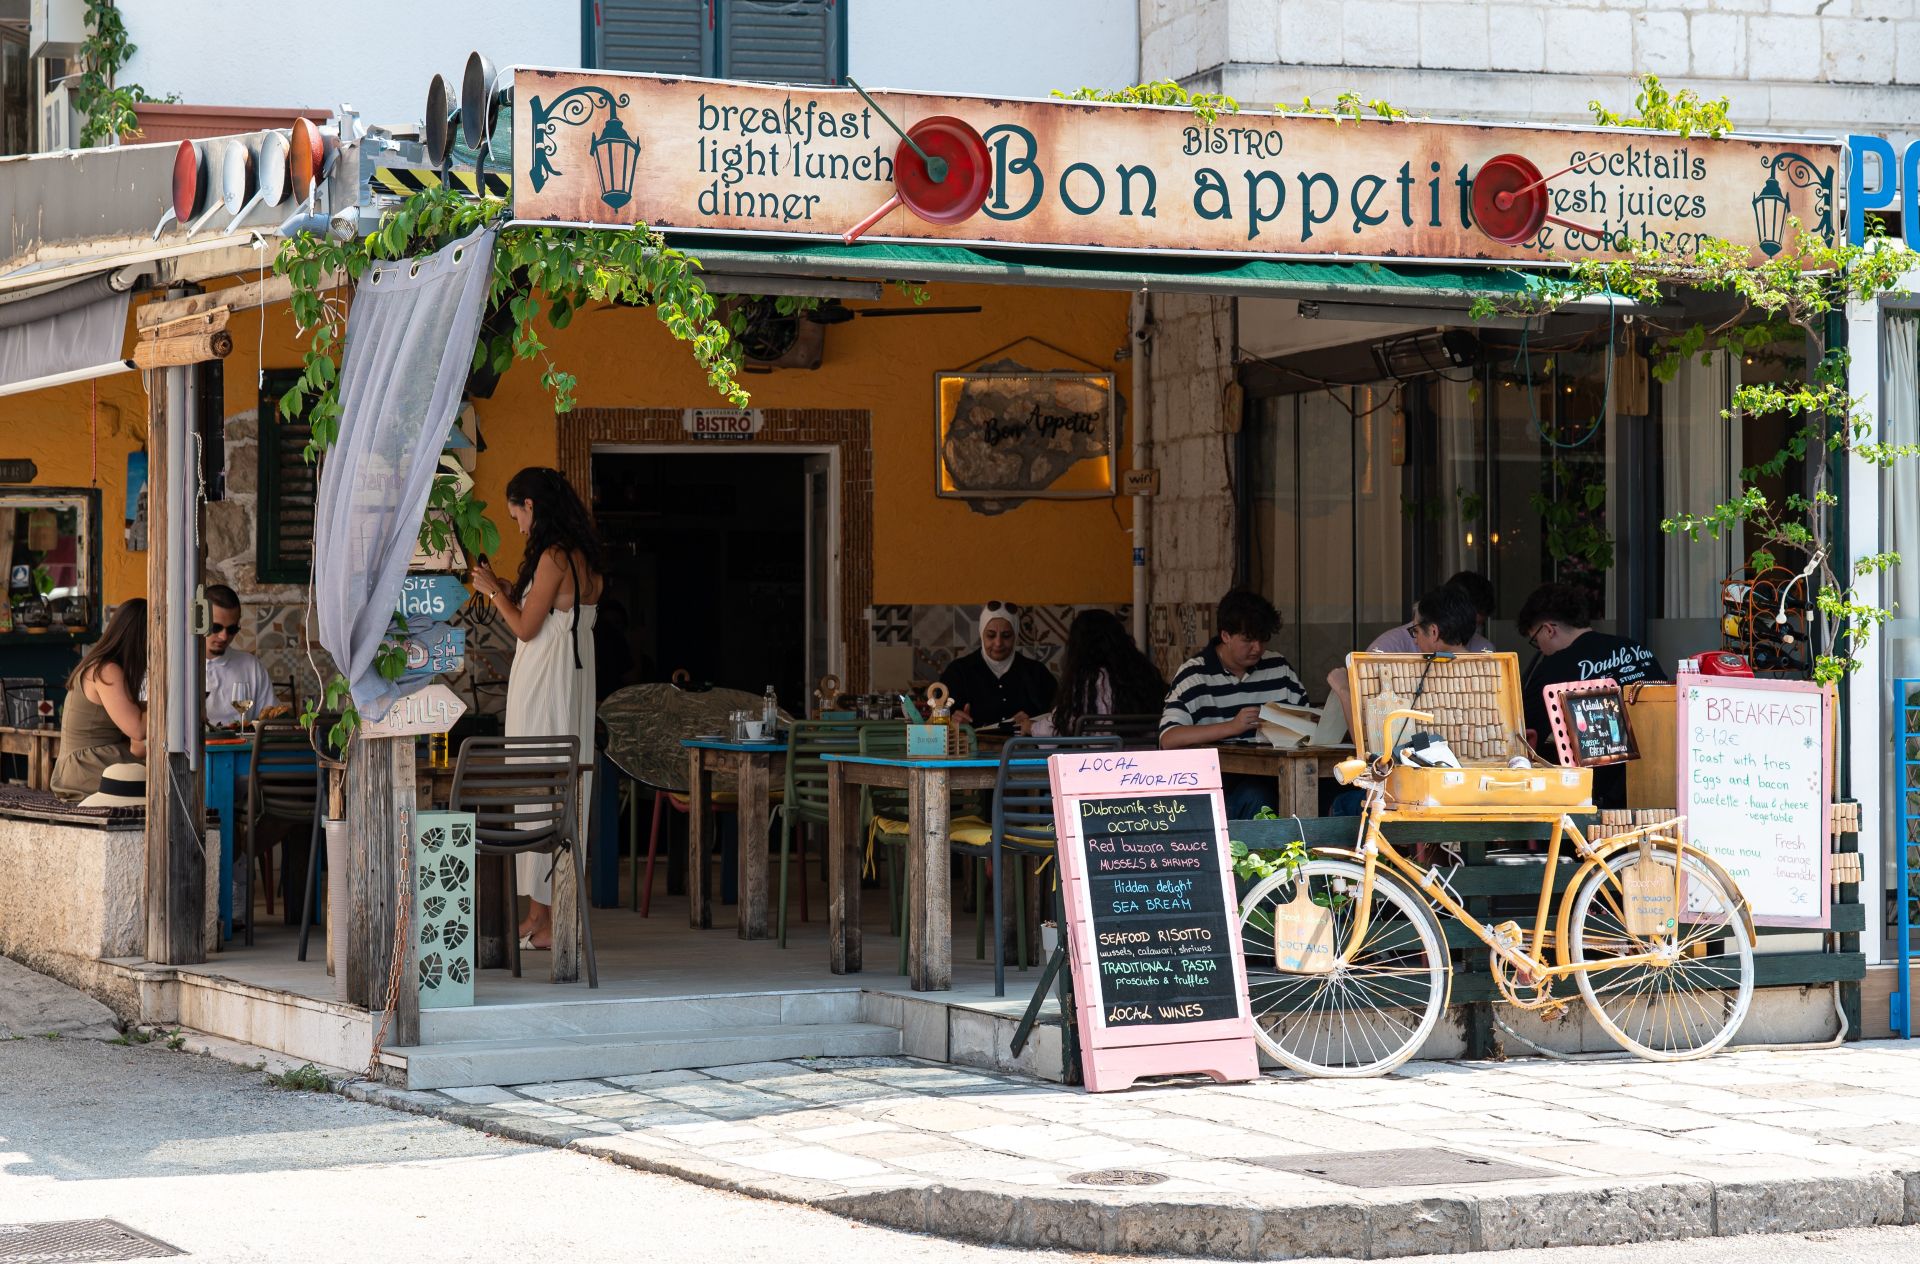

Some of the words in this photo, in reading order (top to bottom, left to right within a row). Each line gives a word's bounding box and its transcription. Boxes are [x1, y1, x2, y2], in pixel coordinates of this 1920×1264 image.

[698, 94, 871, 139] breakfast
[1182, 126, 1284, 159] BISTRO
[698, 136, 780, 184] light
[793, 143, 893, 182] lunch
[1570, 144, 1706, 180] cocktails
[980, 123, 1157, 221] Bon
[1194, 160, 1474, 242] appetit
[698, 180, 820, 223] dinner
[1617, 184, 1706, 222] juices
[1564, 220, 1628, 252] cold
[697, 417, 751, 432] BISTRO
[1026, 404, 1099, 438] Appetit
[1129, 473, 1152, 484] wifi
[395, 589, 445, 618] lads
[1578, 646, 1632, 680] Double
[1630, 645, 1654, 661] You
[1706, 698, 1818, 726] BREAKFAST
[1079, 756, 1138, 773] LOCAL
[1692, 748, 1724, 764] Toast
[1733, 753, 1756, 768] with
[1763, 753, 1791, 770] fries
[1120, 772, 1198, 787] FAVORITES
[1693, 769, 1721, 791] Eggs
[1729, 774, 1750, 786] and
[1758, 775, 1789, 791] bacon
[1779, 799, 1809, 811] cheese
[1108, 820, 1169, 833] OCTOPUS
[1089, 838, 1115, 853] Red
[1121, 837, 1164, 853] buzara
[1170, 840, 1208, 851] sauce
[1775, 833, 1806, 850] Fresh
[1100, 858, 1147, 870] MUSSELS
[1150, 859, 1158, 868] &
[1161, 858, 1201, 868] SHRIMPS
[1777, 855, 1812, 873] orange
[1114, 879, 1149, 893] Hidden
[1156, 878, 1193, 898] delight
[1112, 900, 1139, 913] SEA
[1146, 898, 1192, 911] BREAM
[1099, 931, 1150, 946] SEAFOOD
[1158, 927, 1212, 943] RISOTTO
[1178, 944, 1212, 955] shrimps
[1101, 959, 1174, 975] TRADITIONAL
[1182, 959, 1217, 972] PASTA
[1163, 976, 1170, 985] &
[1173, 974, 1209, 988] truffles
[1108, 1005, 1152, 1021] LOCAL
[1157, 1003, 1204, 1019] WINES
